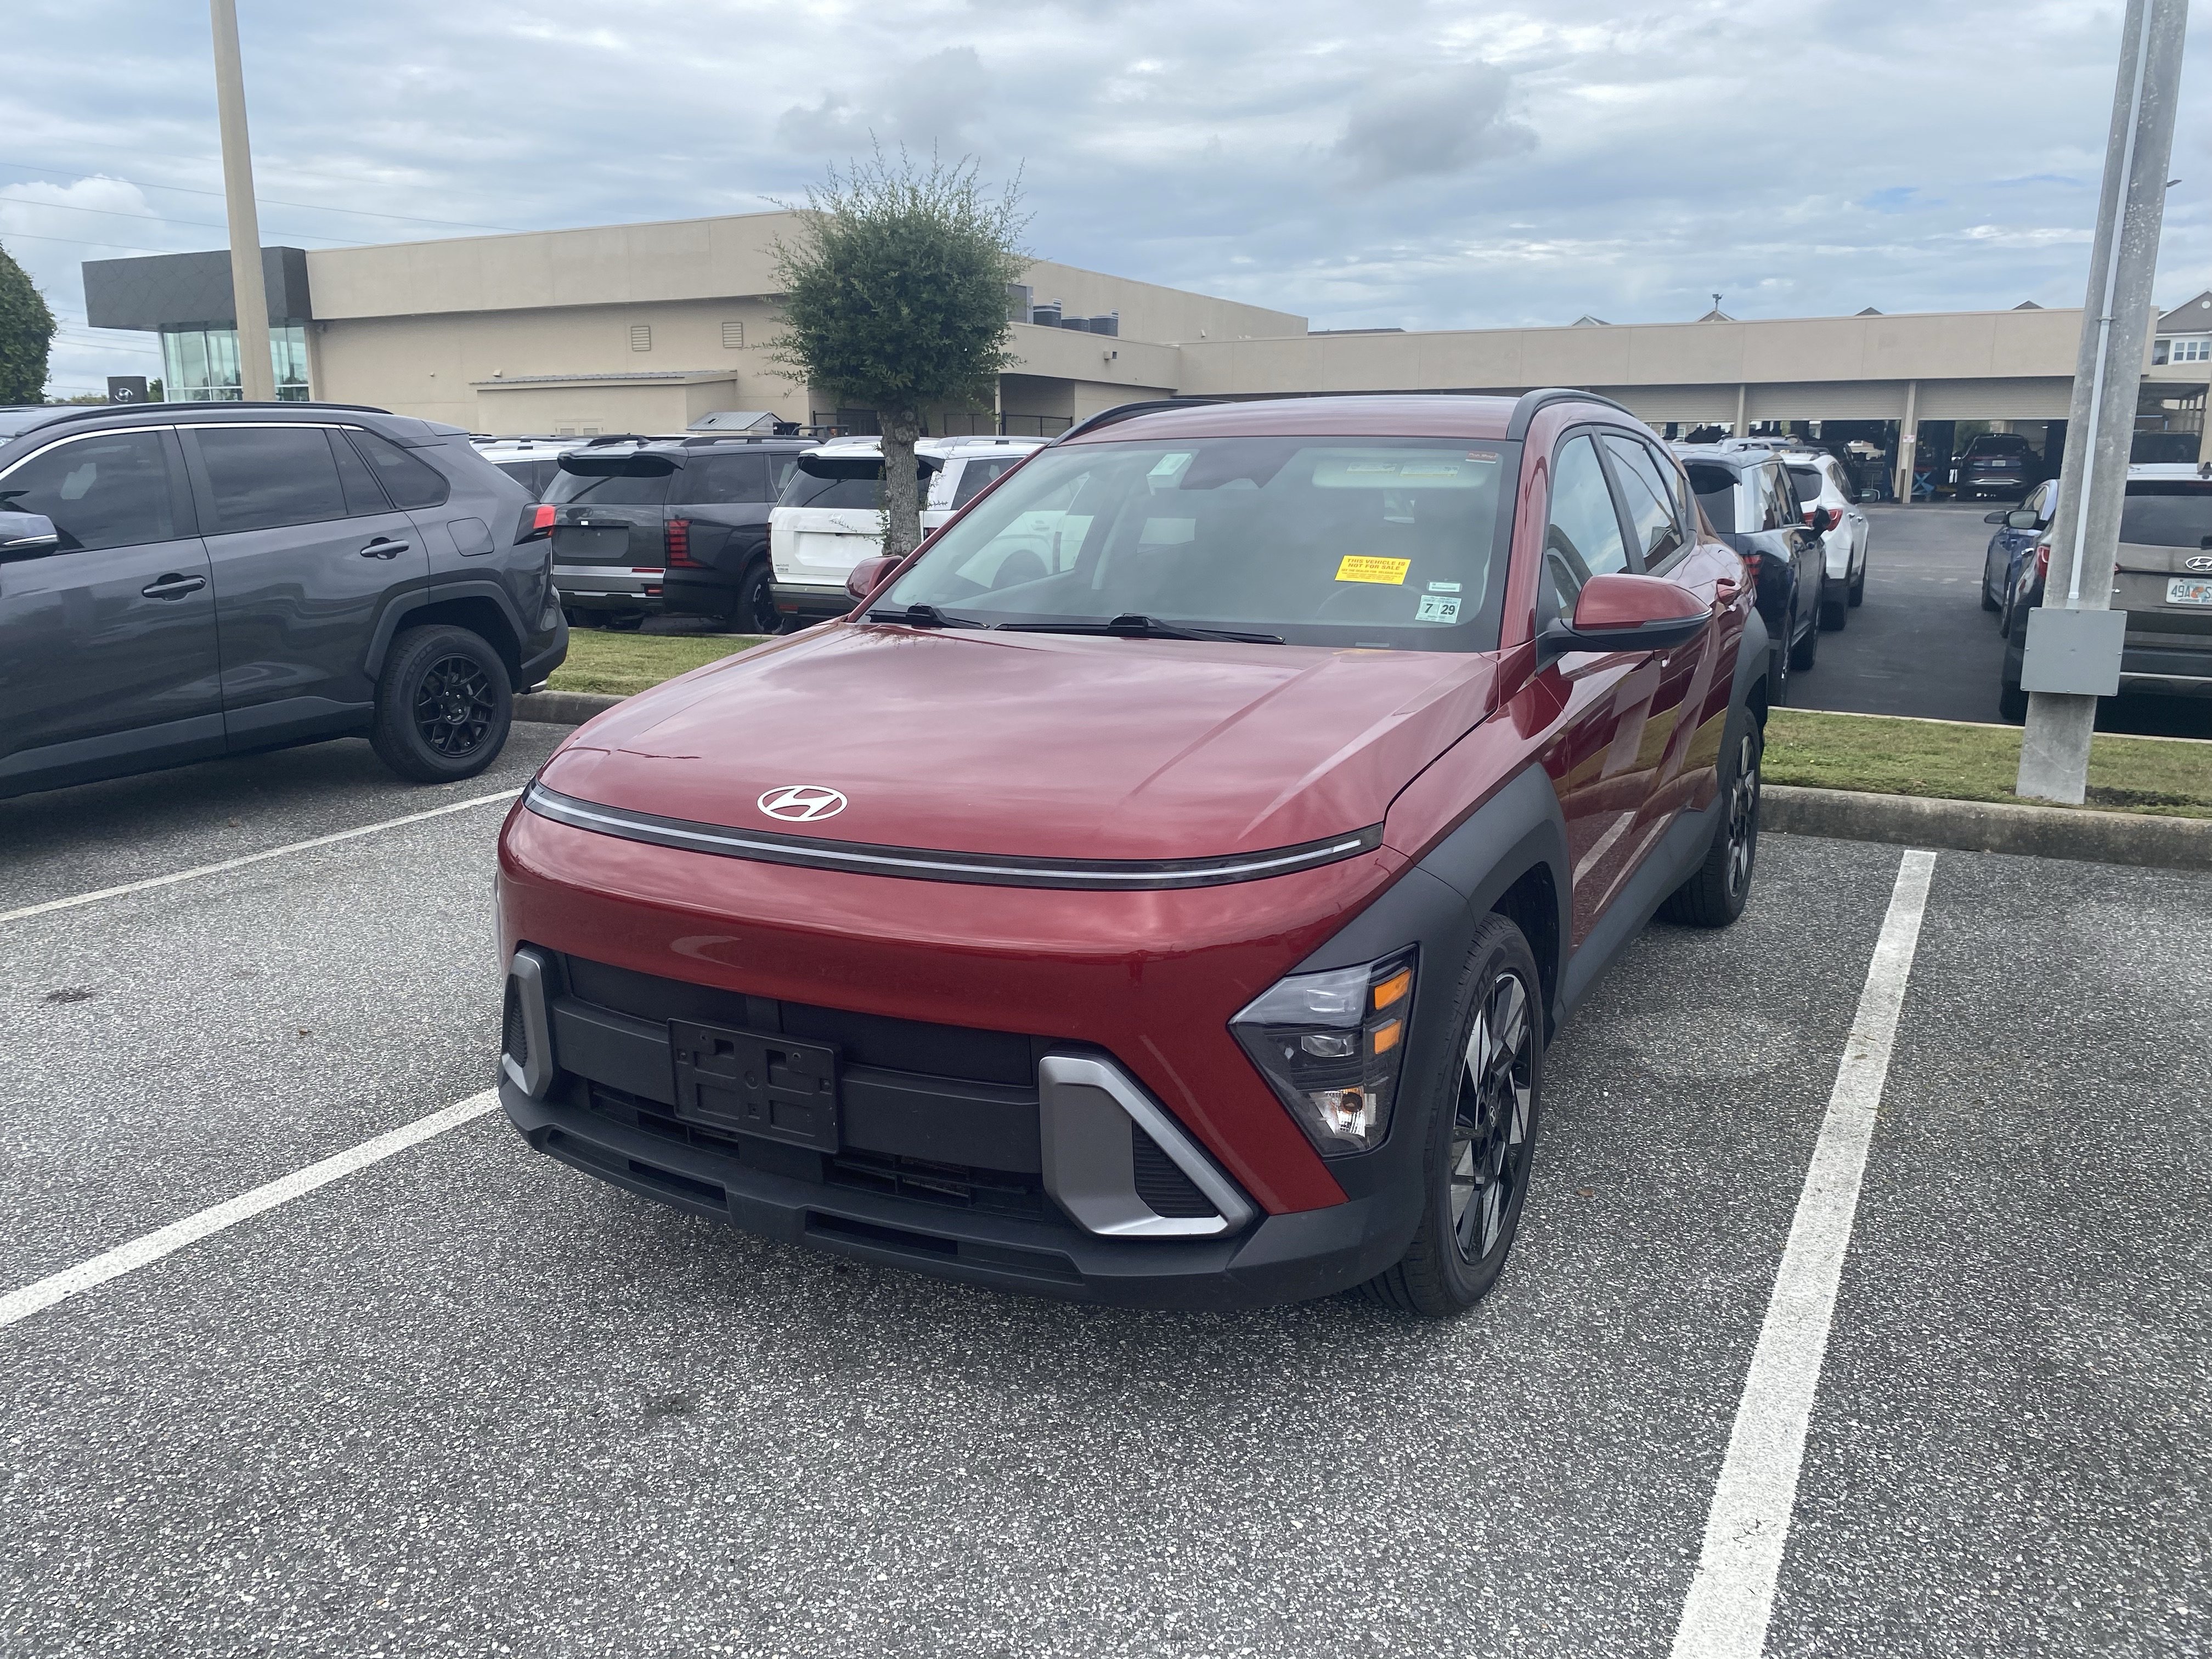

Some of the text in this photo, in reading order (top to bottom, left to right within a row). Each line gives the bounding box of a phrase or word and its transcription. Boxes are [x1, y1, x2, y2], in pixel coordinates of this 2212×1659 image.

[2171, 585, 2212, 599] 49A S
[1425, 603, 1455, 615] 7 29
